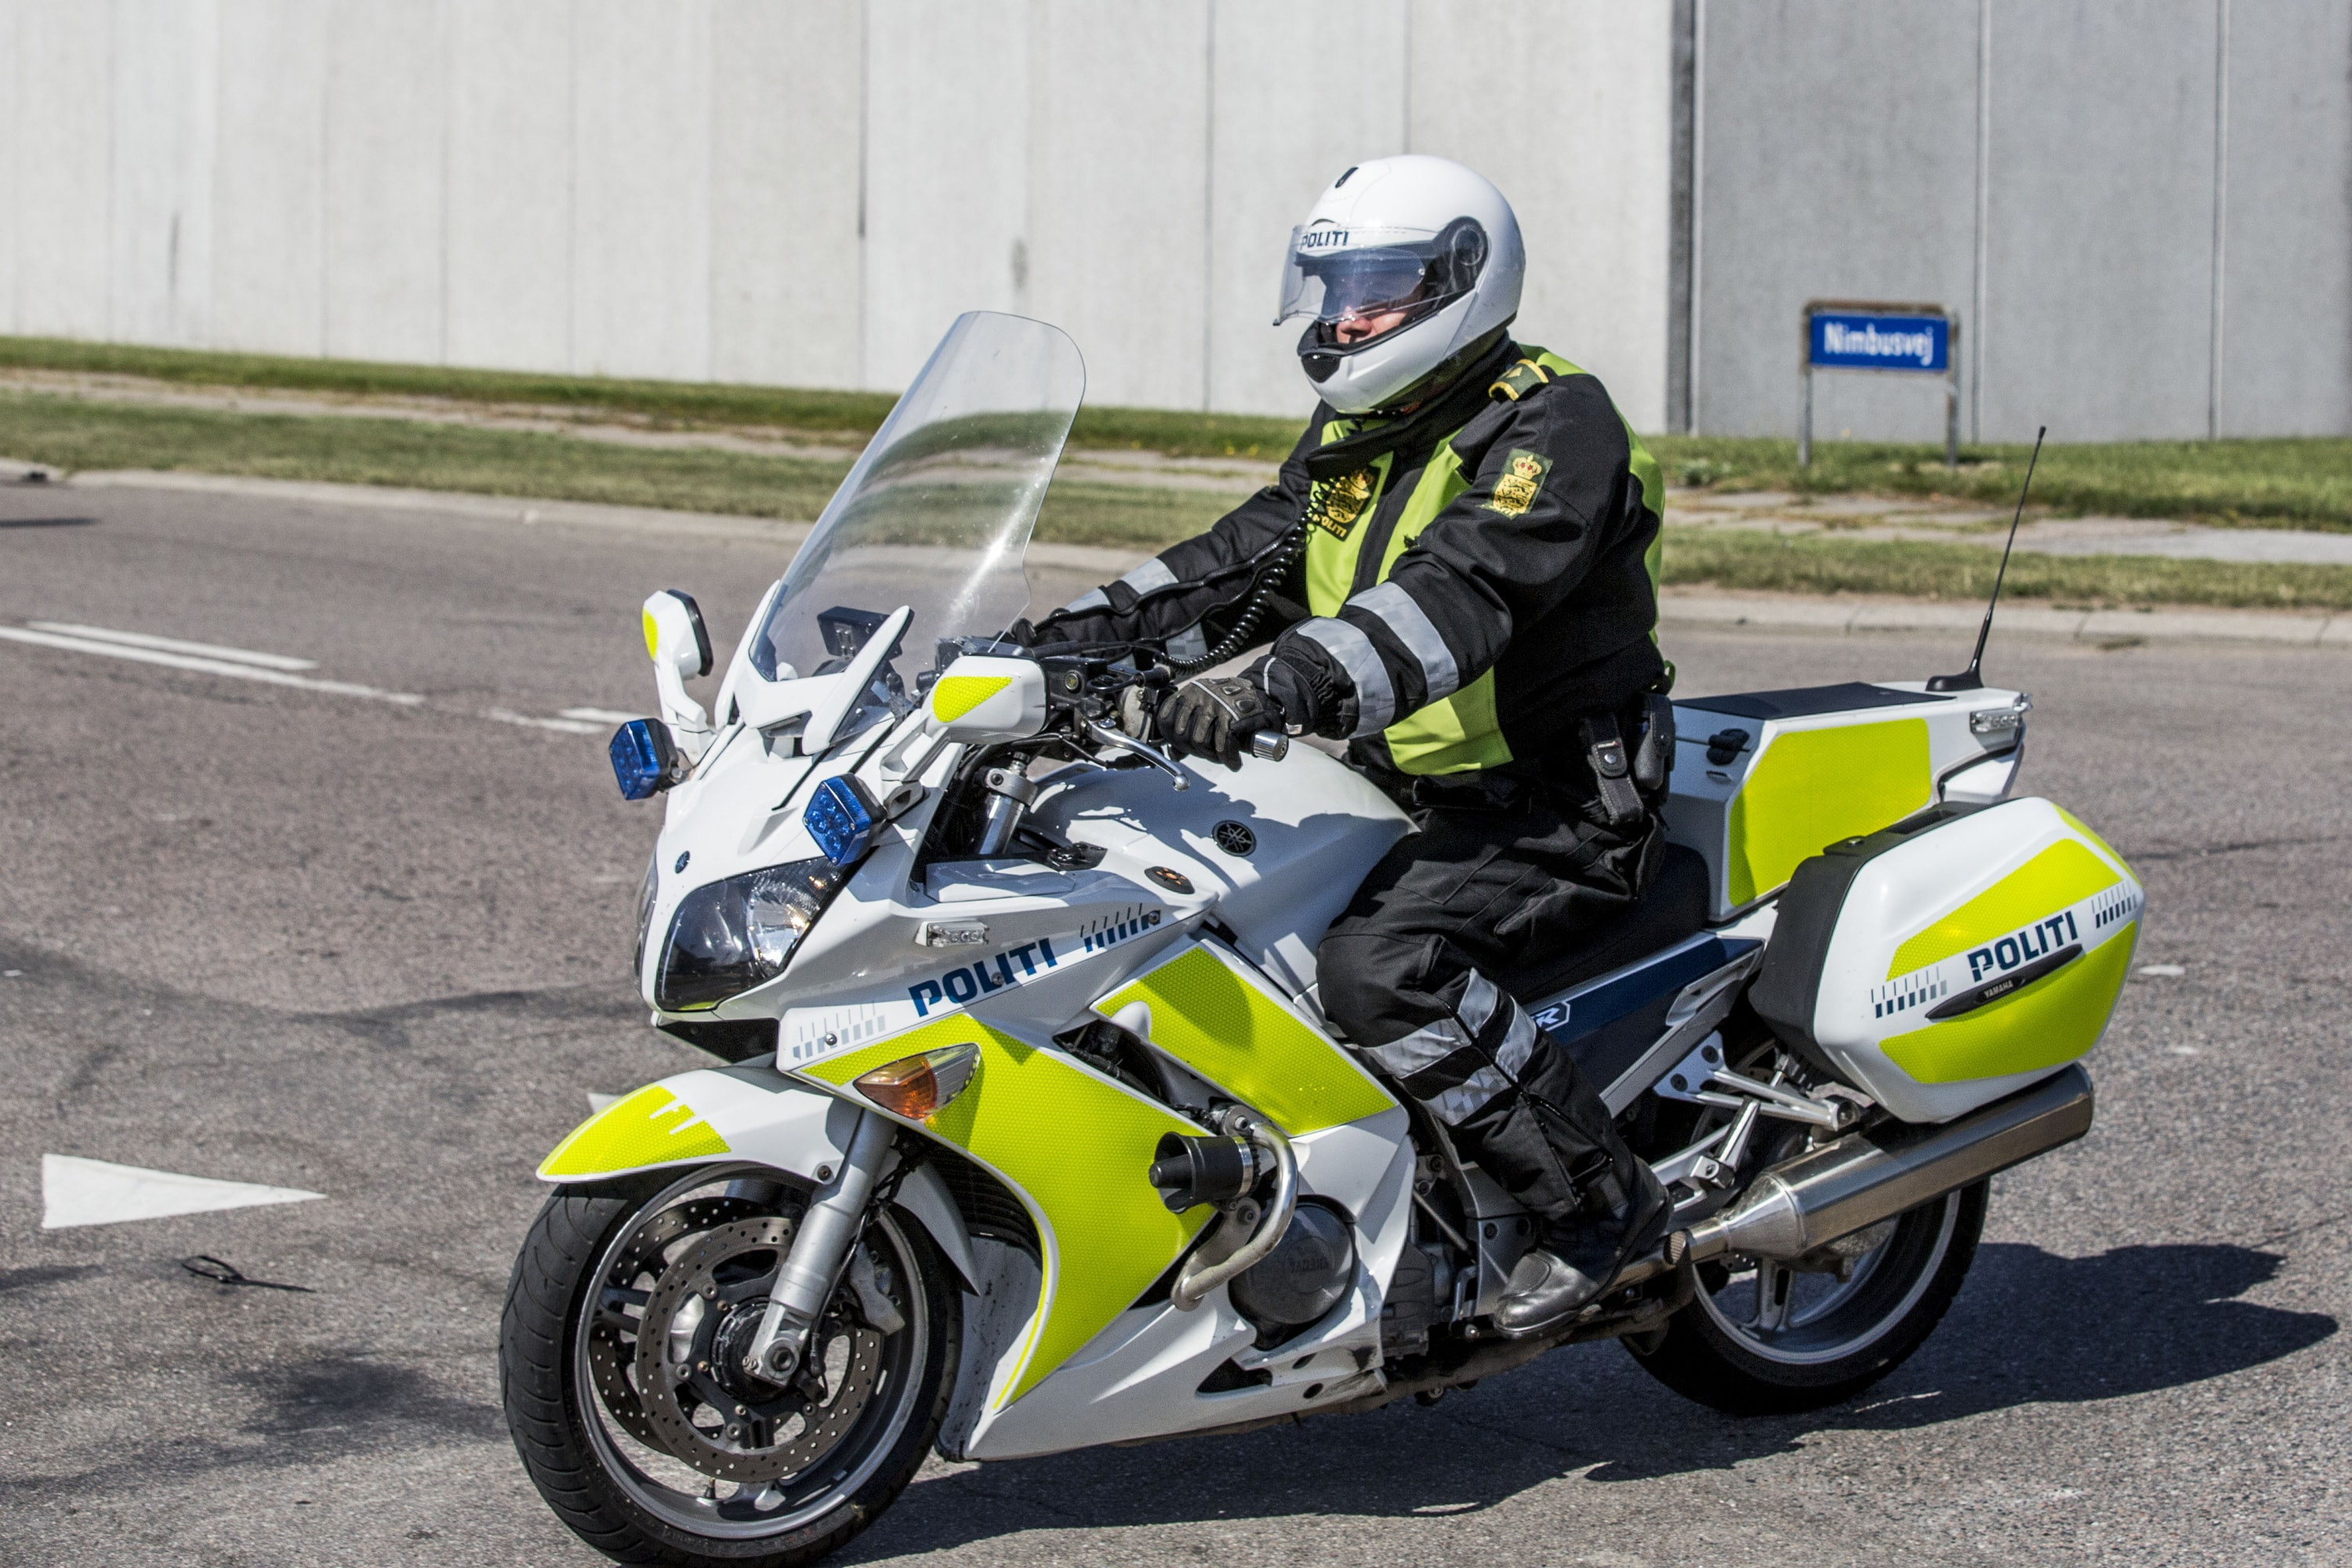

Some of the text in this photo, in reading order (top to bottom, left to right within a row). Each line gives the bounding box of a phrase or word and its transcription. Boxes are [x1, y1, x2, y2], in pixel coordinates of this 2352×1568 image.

[1300, 230, 1349, 250] POLITI
[1824, 321, 1934, 366] Nimbusvej
[1967, 910, 2078, 982] POLITI
[908, 938, 1058, 1018] POLITI
[1984, 980, 2013, 999] YAMAHA
